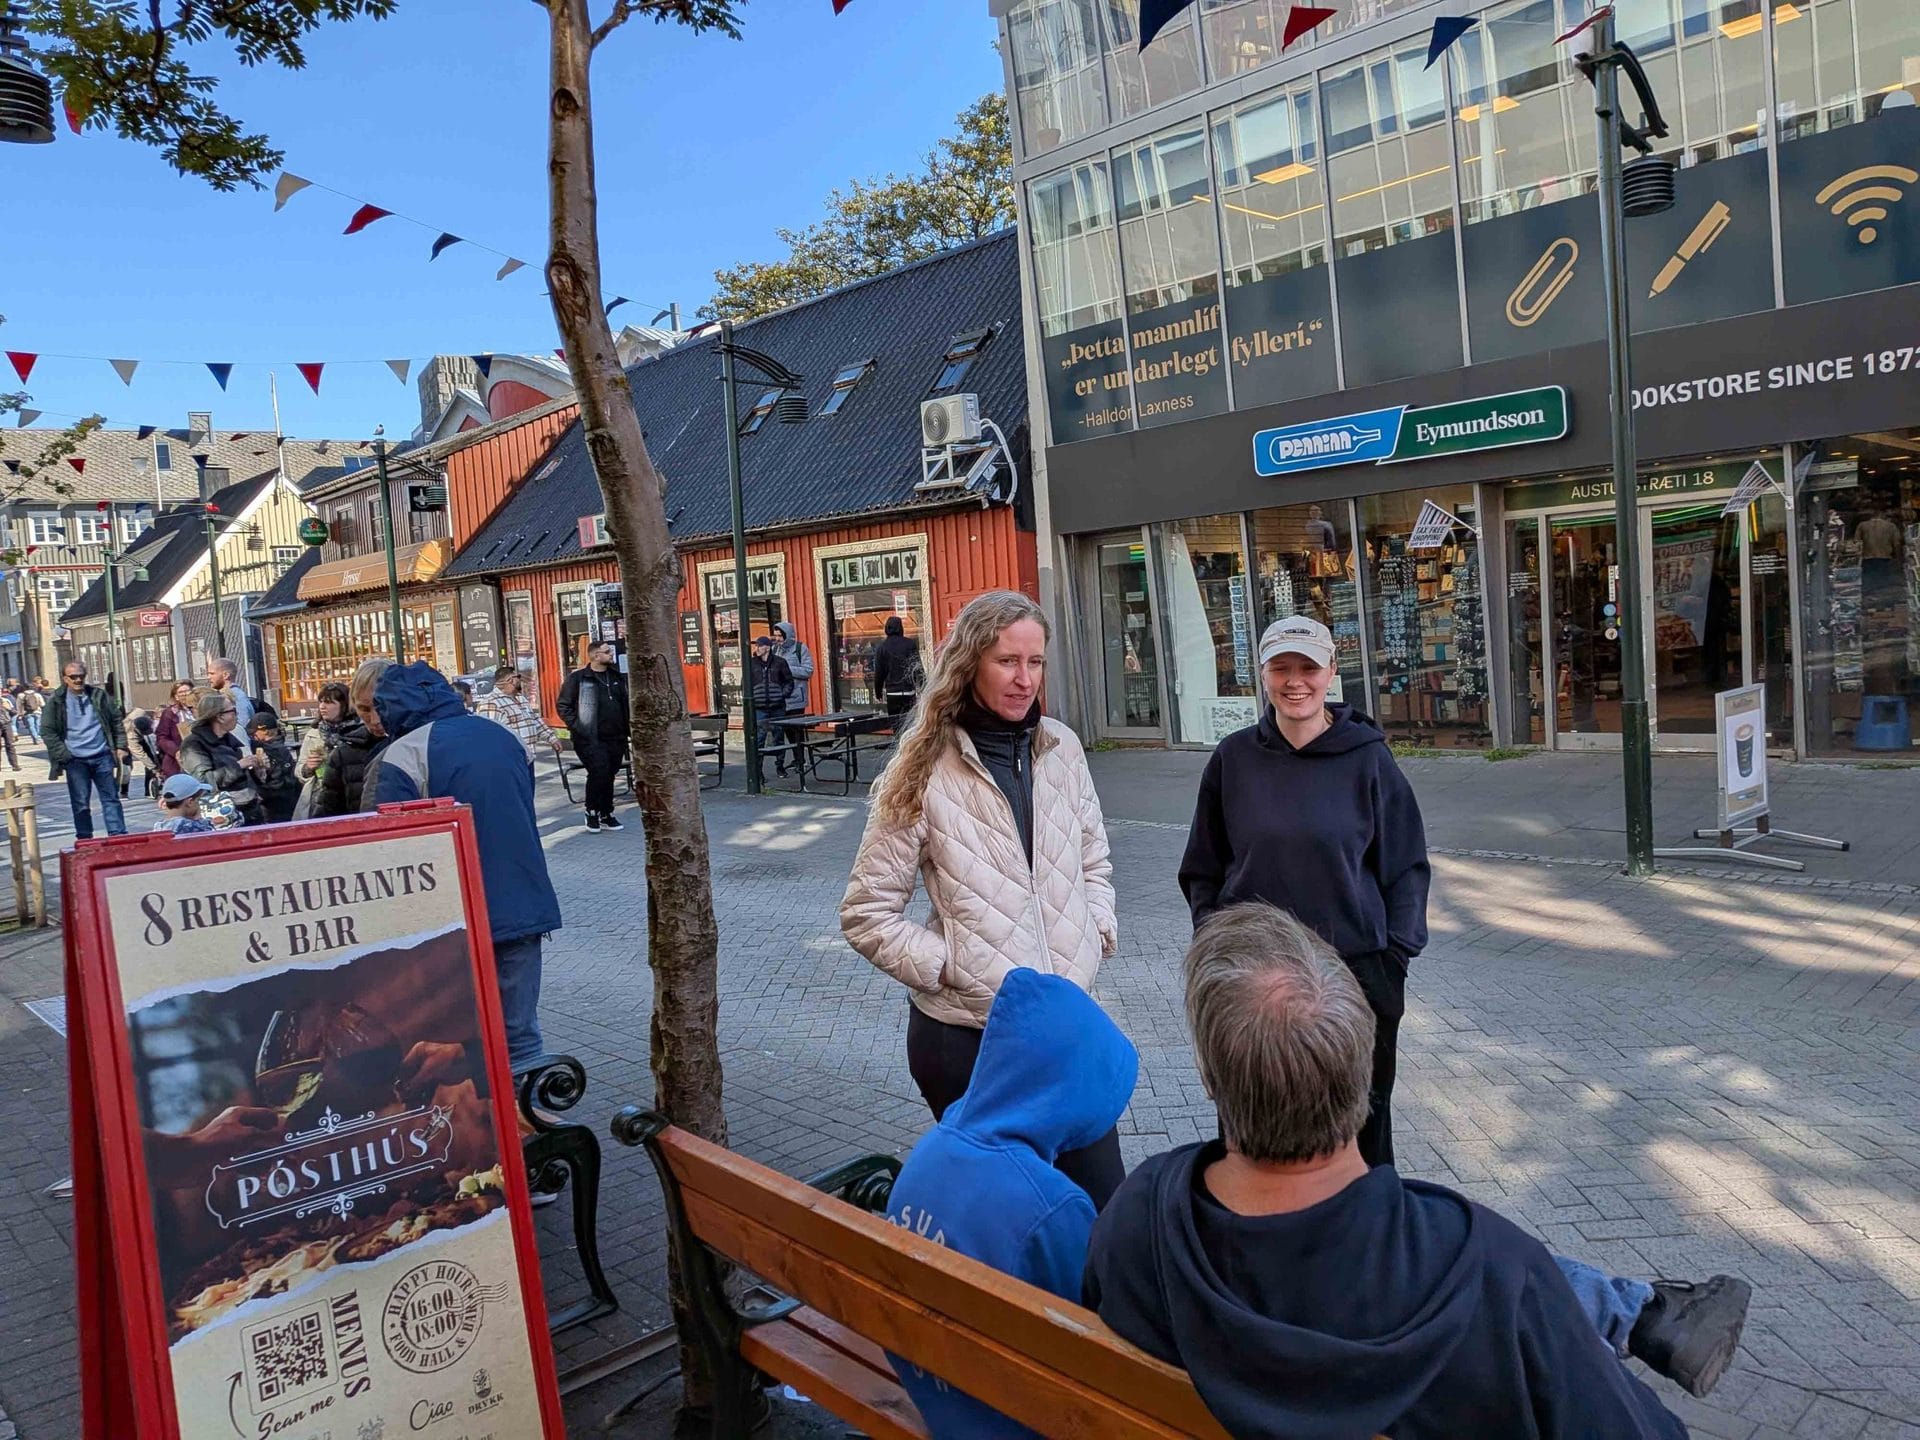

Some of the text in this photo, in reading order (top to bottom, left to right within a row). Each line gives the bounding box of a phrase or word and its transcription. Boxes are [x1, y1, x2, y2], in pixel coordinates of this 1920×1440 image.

[1132, 303, 1221, 349] mannlíf
[1074, 376, 1097, 397] er
[1102, 348, 1218, 392] undarlegt
[1608, 370, 1761, 413] OOKSTORE
[1767, 356, 1854, 389] SINCE
[1138, 393, 1194, 418] Laxness
[1415, 408, 1545, 446] Eymundsson
[1692, 471, 1715, 486] 18
[1429, 526, 1446, 534] FREE
[712, 567, 777, 598] LEMY
[831, 553, 917, 586] LEMMY
[140, 862, 437, 947] 8 RESTAURANTS
[245, 915, 360, 964] & BAR
[237, 1127, 430, 1209] PÓSTHÚS
[388, 1265, 473, 1316] HAPPY HOUR
[410, 1288, 454, 1321] 16:00
[329, 1288, 371, 1398] MENUS
[415, 1311, 457, 1343] 18:00
[390, 1332, 417, 1364] FOOD
[419, 1346, 455, 1367] HALL
[455, 1337, 467, 1348] &
[258, 1411, 307, 1440] Scan
[310, 1395, 336, 1415] me
[409, 1399, 453, 1431] Ciao
[467, 1392, 505, 1415] DRYKK
